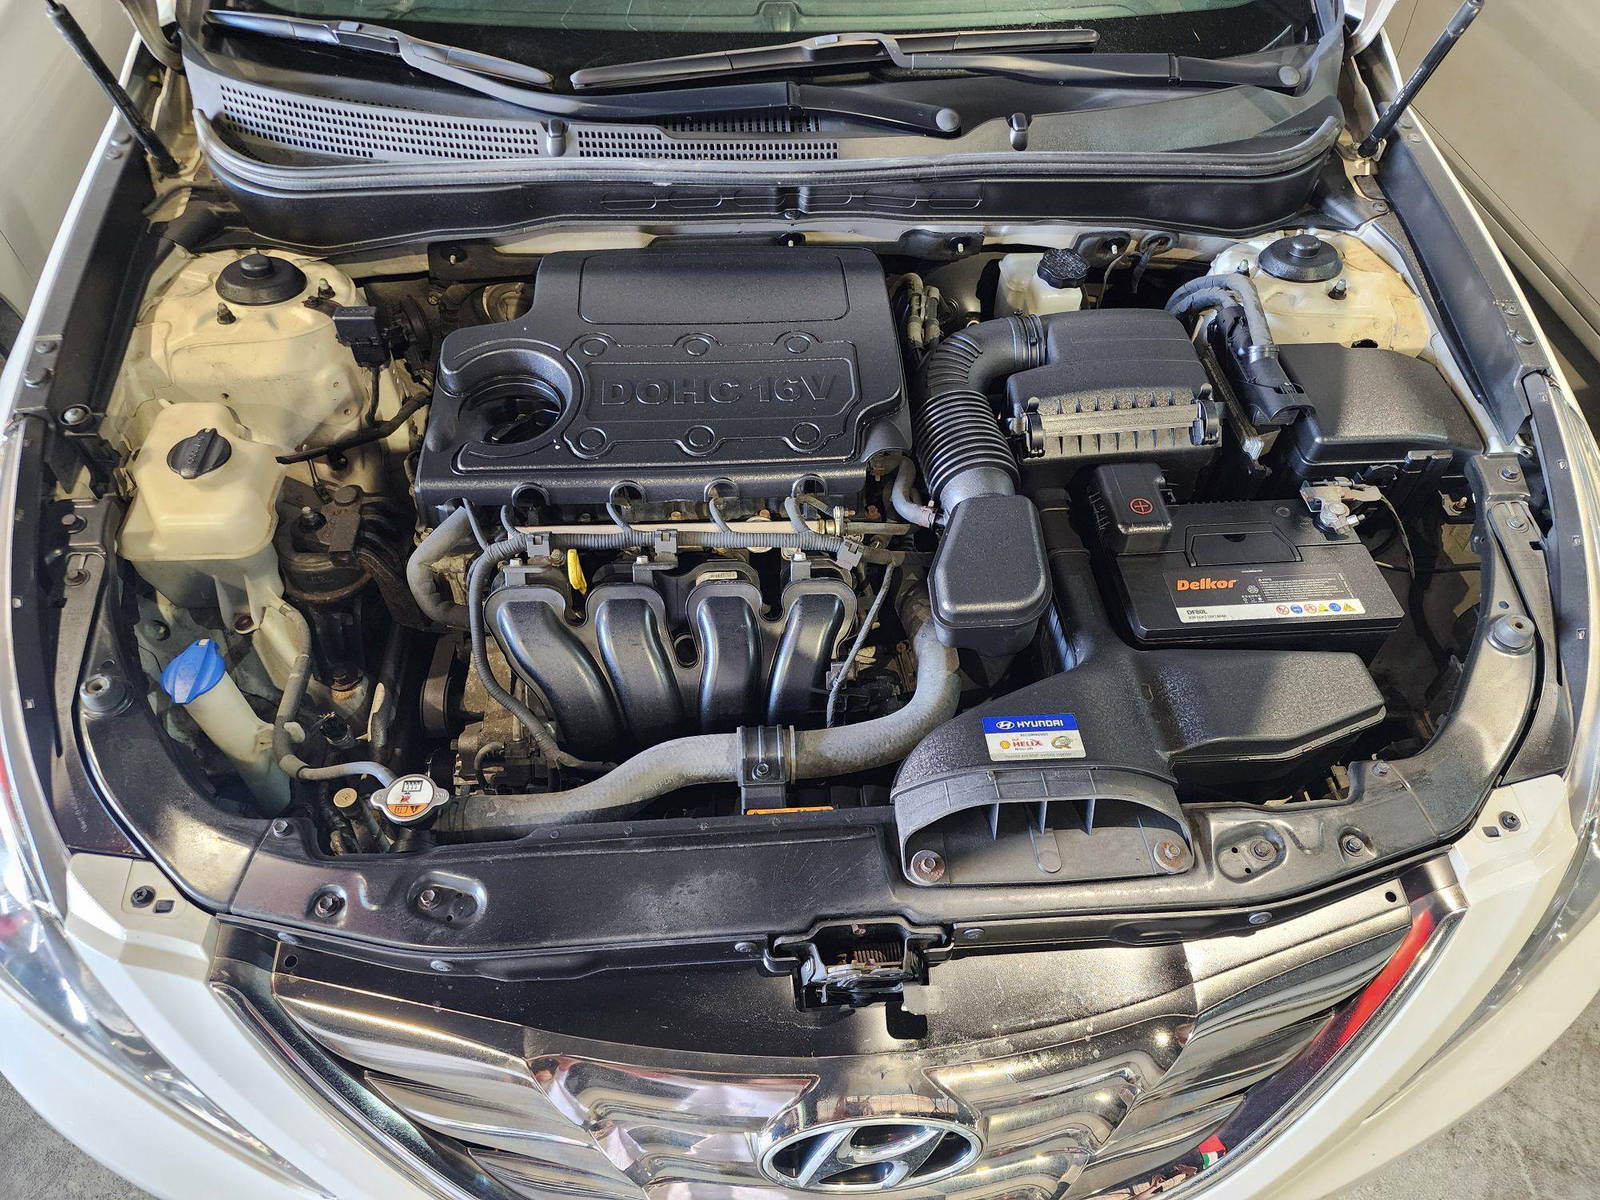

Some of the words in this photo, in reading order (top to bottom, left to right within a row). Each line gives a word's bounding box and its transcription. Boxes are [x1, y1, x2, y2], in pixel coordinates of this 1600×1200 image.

[601, 378, 741, 405] DOHC
[750, 375, 837, 402] 16V
[1176, 577, 1237, 591] Delkor
[1016, 719, 1064, 729] HYUNDAI
[1012, 740, 1042, 748] HELIX
